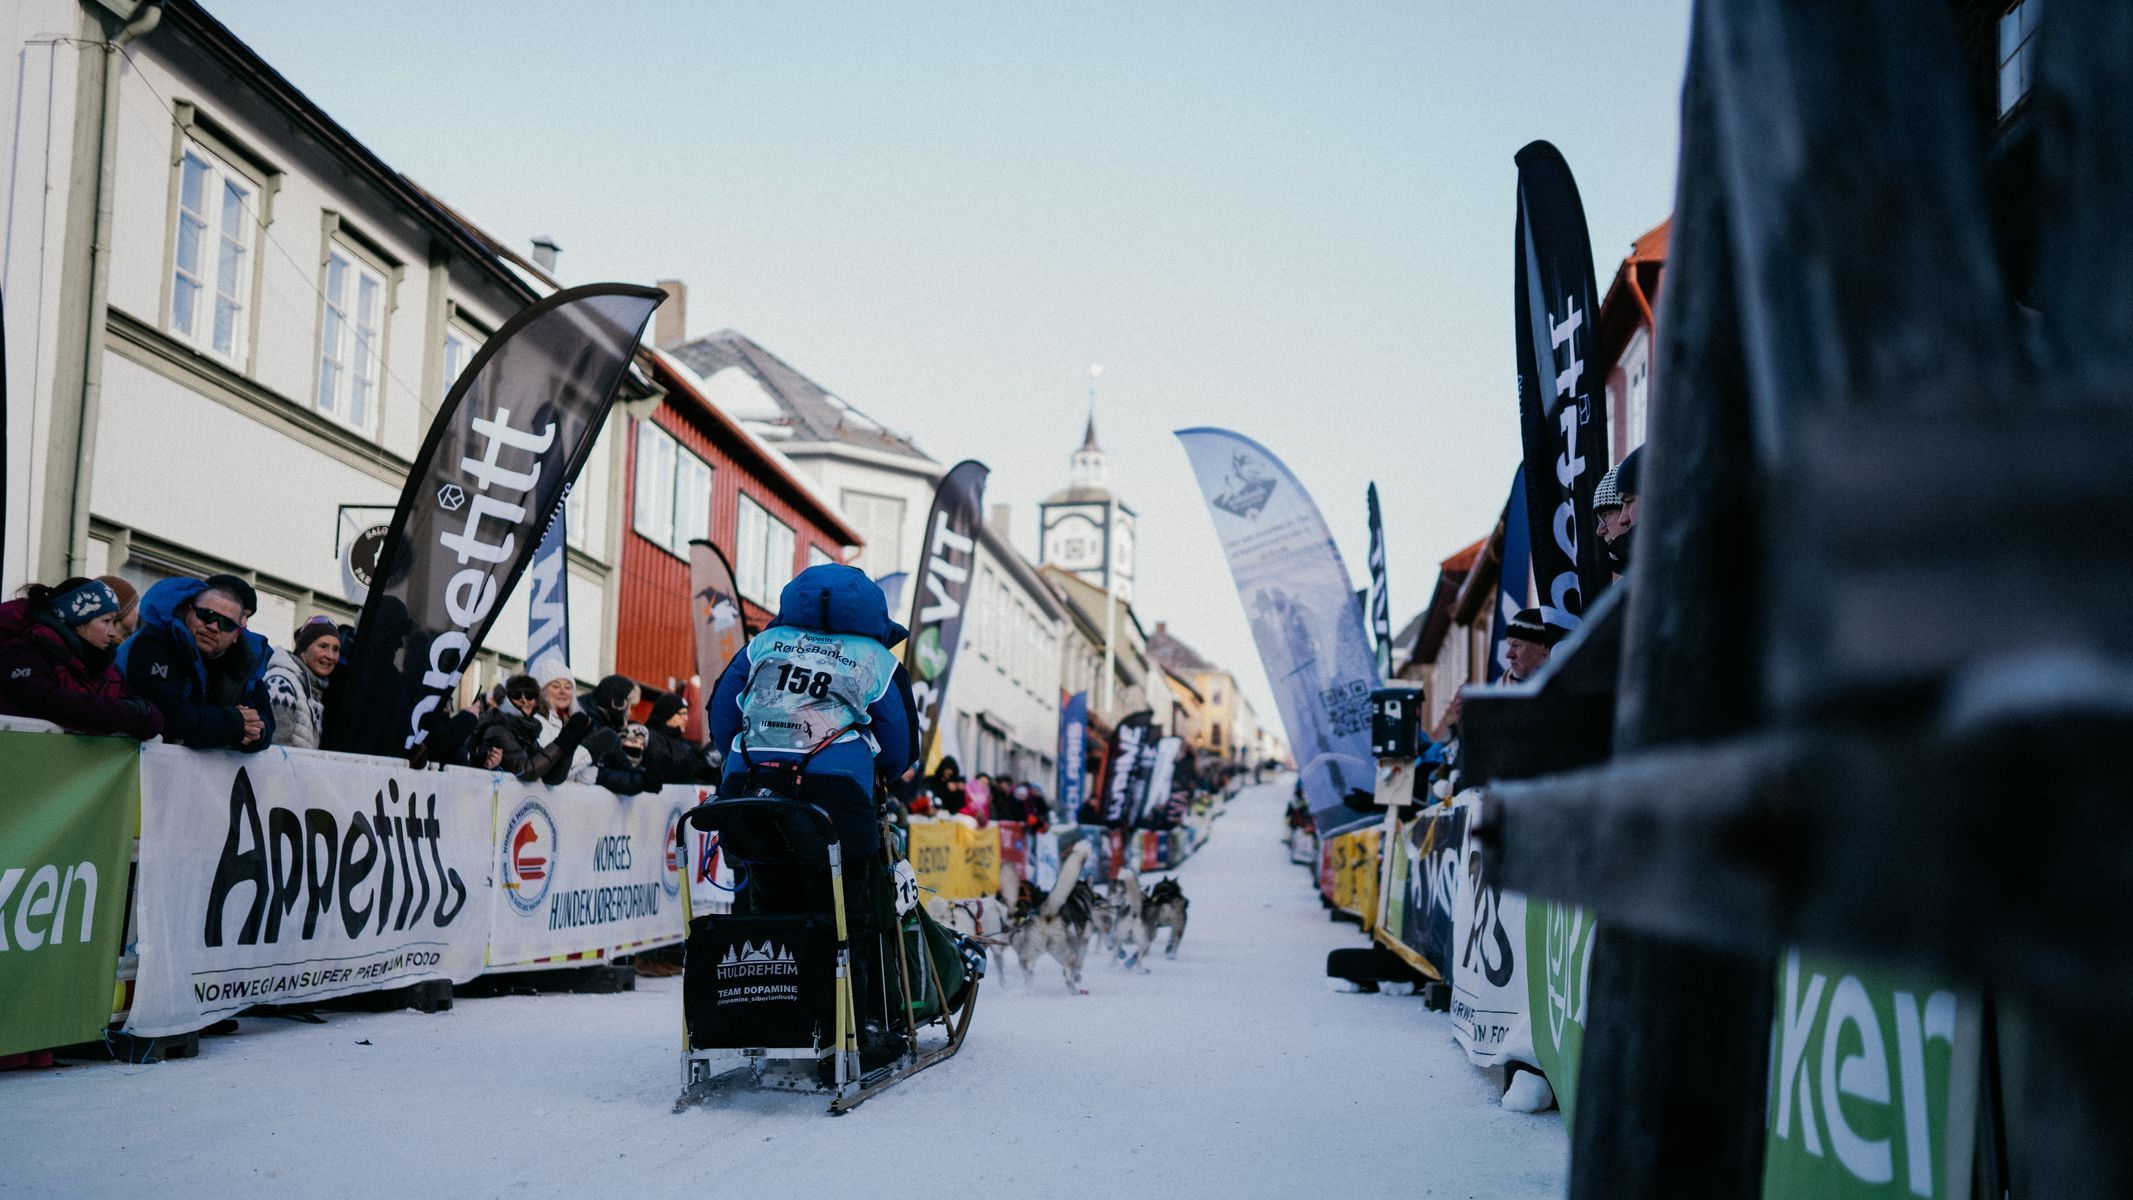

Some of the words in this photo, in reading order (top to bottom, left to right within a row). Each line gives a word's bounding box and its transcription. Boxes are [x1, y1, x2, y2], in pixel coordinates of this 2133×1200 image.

[773, 641, 857, 668] RørosBanken
[776, 663, 833, 699] 158
[593, 835, 632, 872] NORGES
[194, 975, 299, 1004] NORWEGIAN
[353, 954, 404, 980] PREMUM
[405, 952, 440, 967] FOOD
[717, 964, 798, 979] HULDREHEIM
[718, 987, 741, 998] TEAM
[744, 984, 798, 995] DOPAMINE
